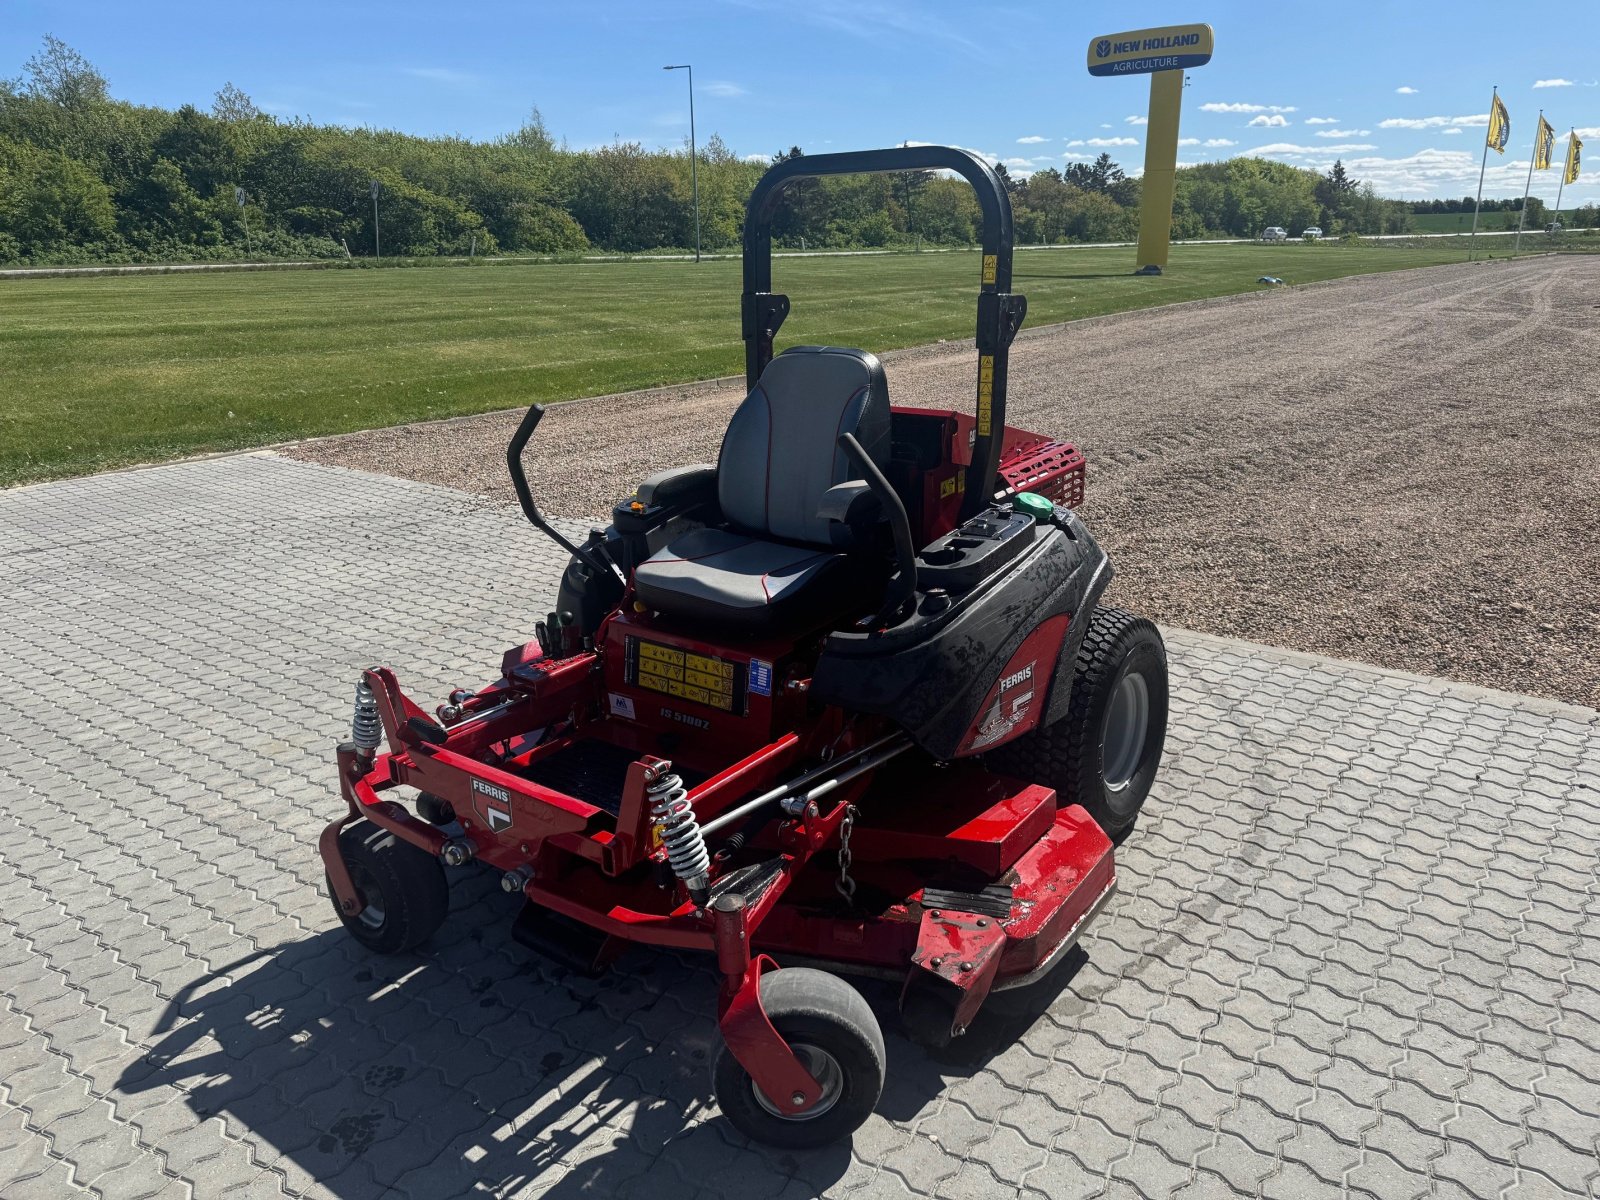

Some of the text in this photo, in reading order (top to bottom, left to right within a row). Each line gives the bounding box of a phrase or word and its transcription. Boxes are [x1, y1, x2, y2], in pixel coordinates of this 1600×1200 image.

[1113, 33, 1200, 54] NEW HOLLAND
[1112, 56, 1179, 72] AGRICULTURE
[1000, 666, 1032, 693] FERRIS
[660, 707, 710, 730] IS 5100Z
[472, 780, 509, 802] FERRIS
